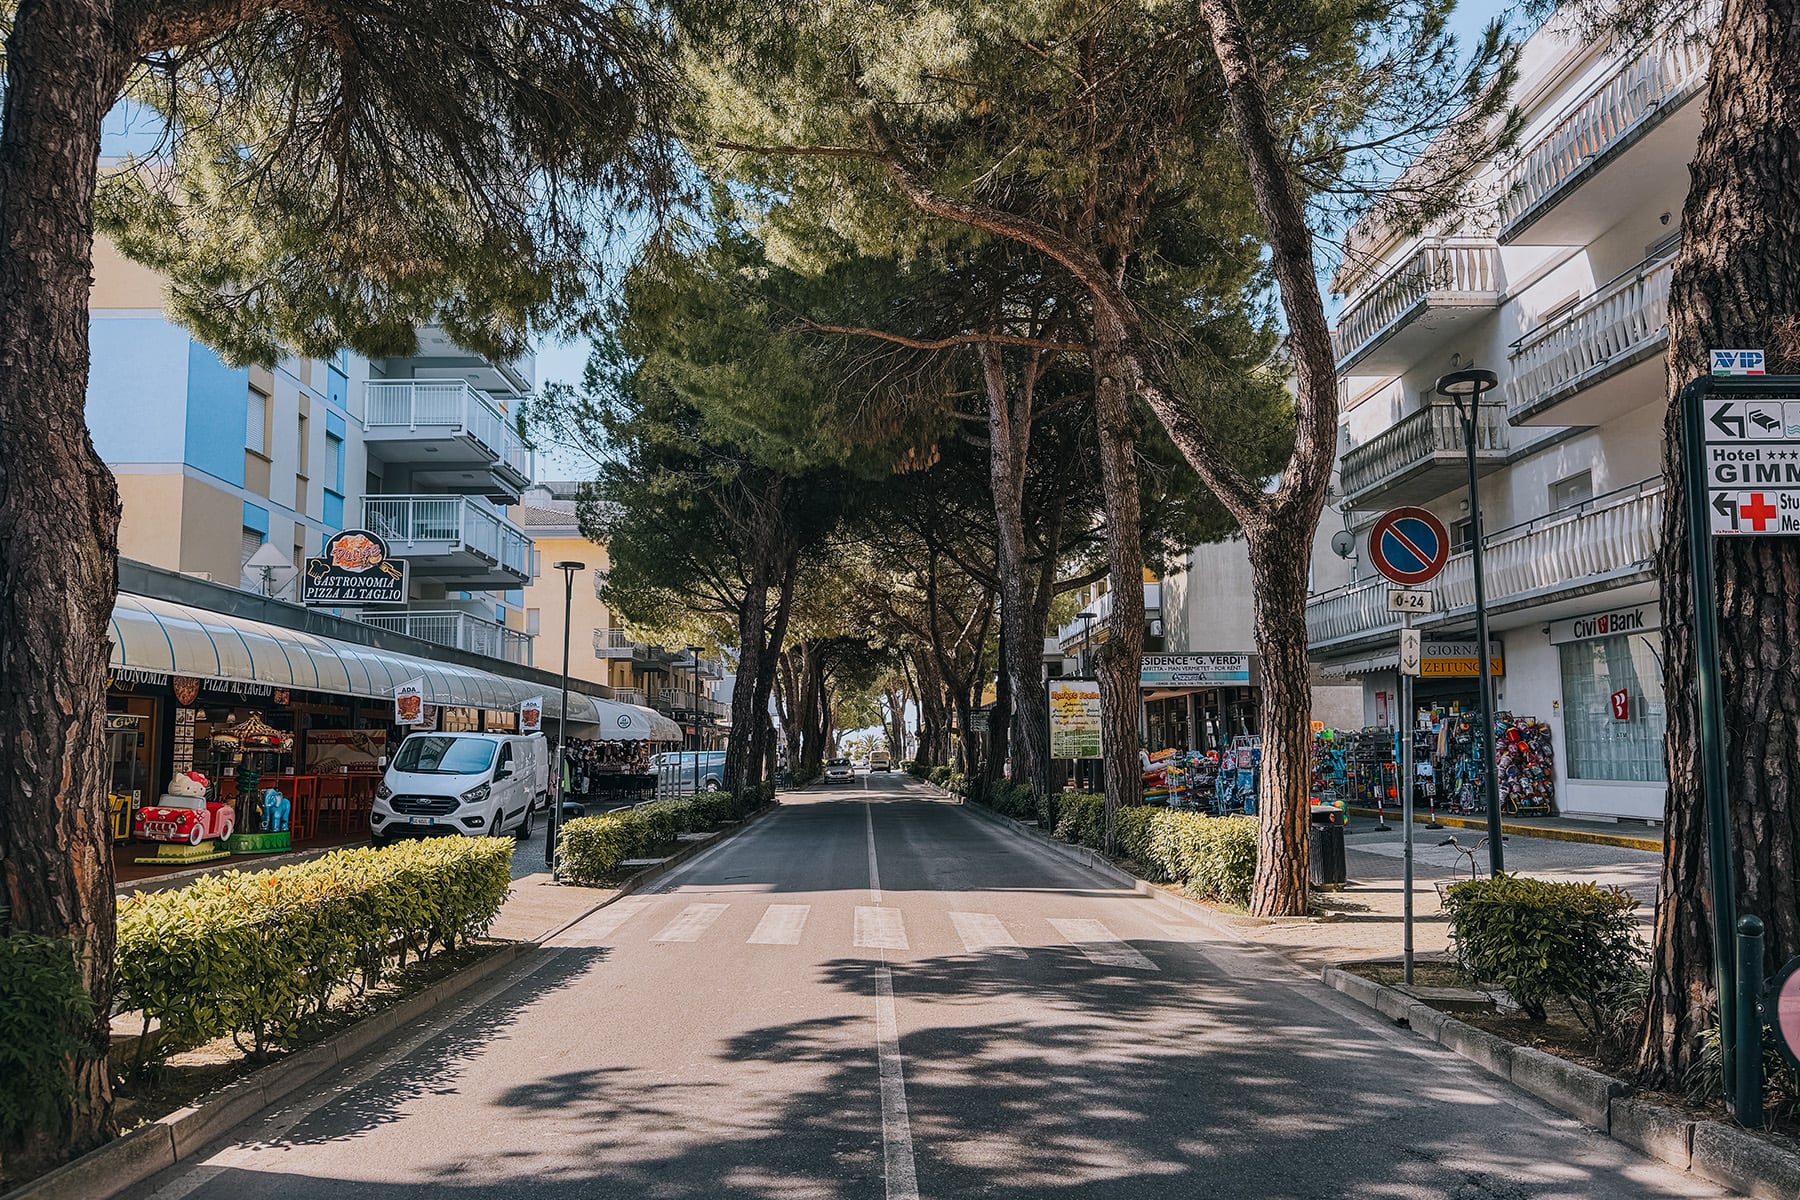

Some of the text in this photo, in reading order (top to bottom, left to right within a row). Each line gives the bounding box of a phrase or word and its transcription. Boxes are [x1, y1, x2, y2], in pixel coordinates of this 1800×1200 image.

[1714, 352, 1763, 368] AVIP
[1713, 449, 1761, 461] Hotel
[1780, 493, 1800, 510] Stu
[1782, 515, 1800, 531] Me
[313, 576, 395, 588] GASTRONOMIA
[306, 588, 401, 600] PIZZA AL TAGLIO
[1395, 595, 1424, 608] 0-24
[1610, 609, 1644, 633] Bank
[1427, 645, 1494, 656] GIORNAI
[1424, 662, 1499, 673] ZEITUNGN
[203, 679, 228, 693] PIZZA
[230, 682, 242, 694] AL
